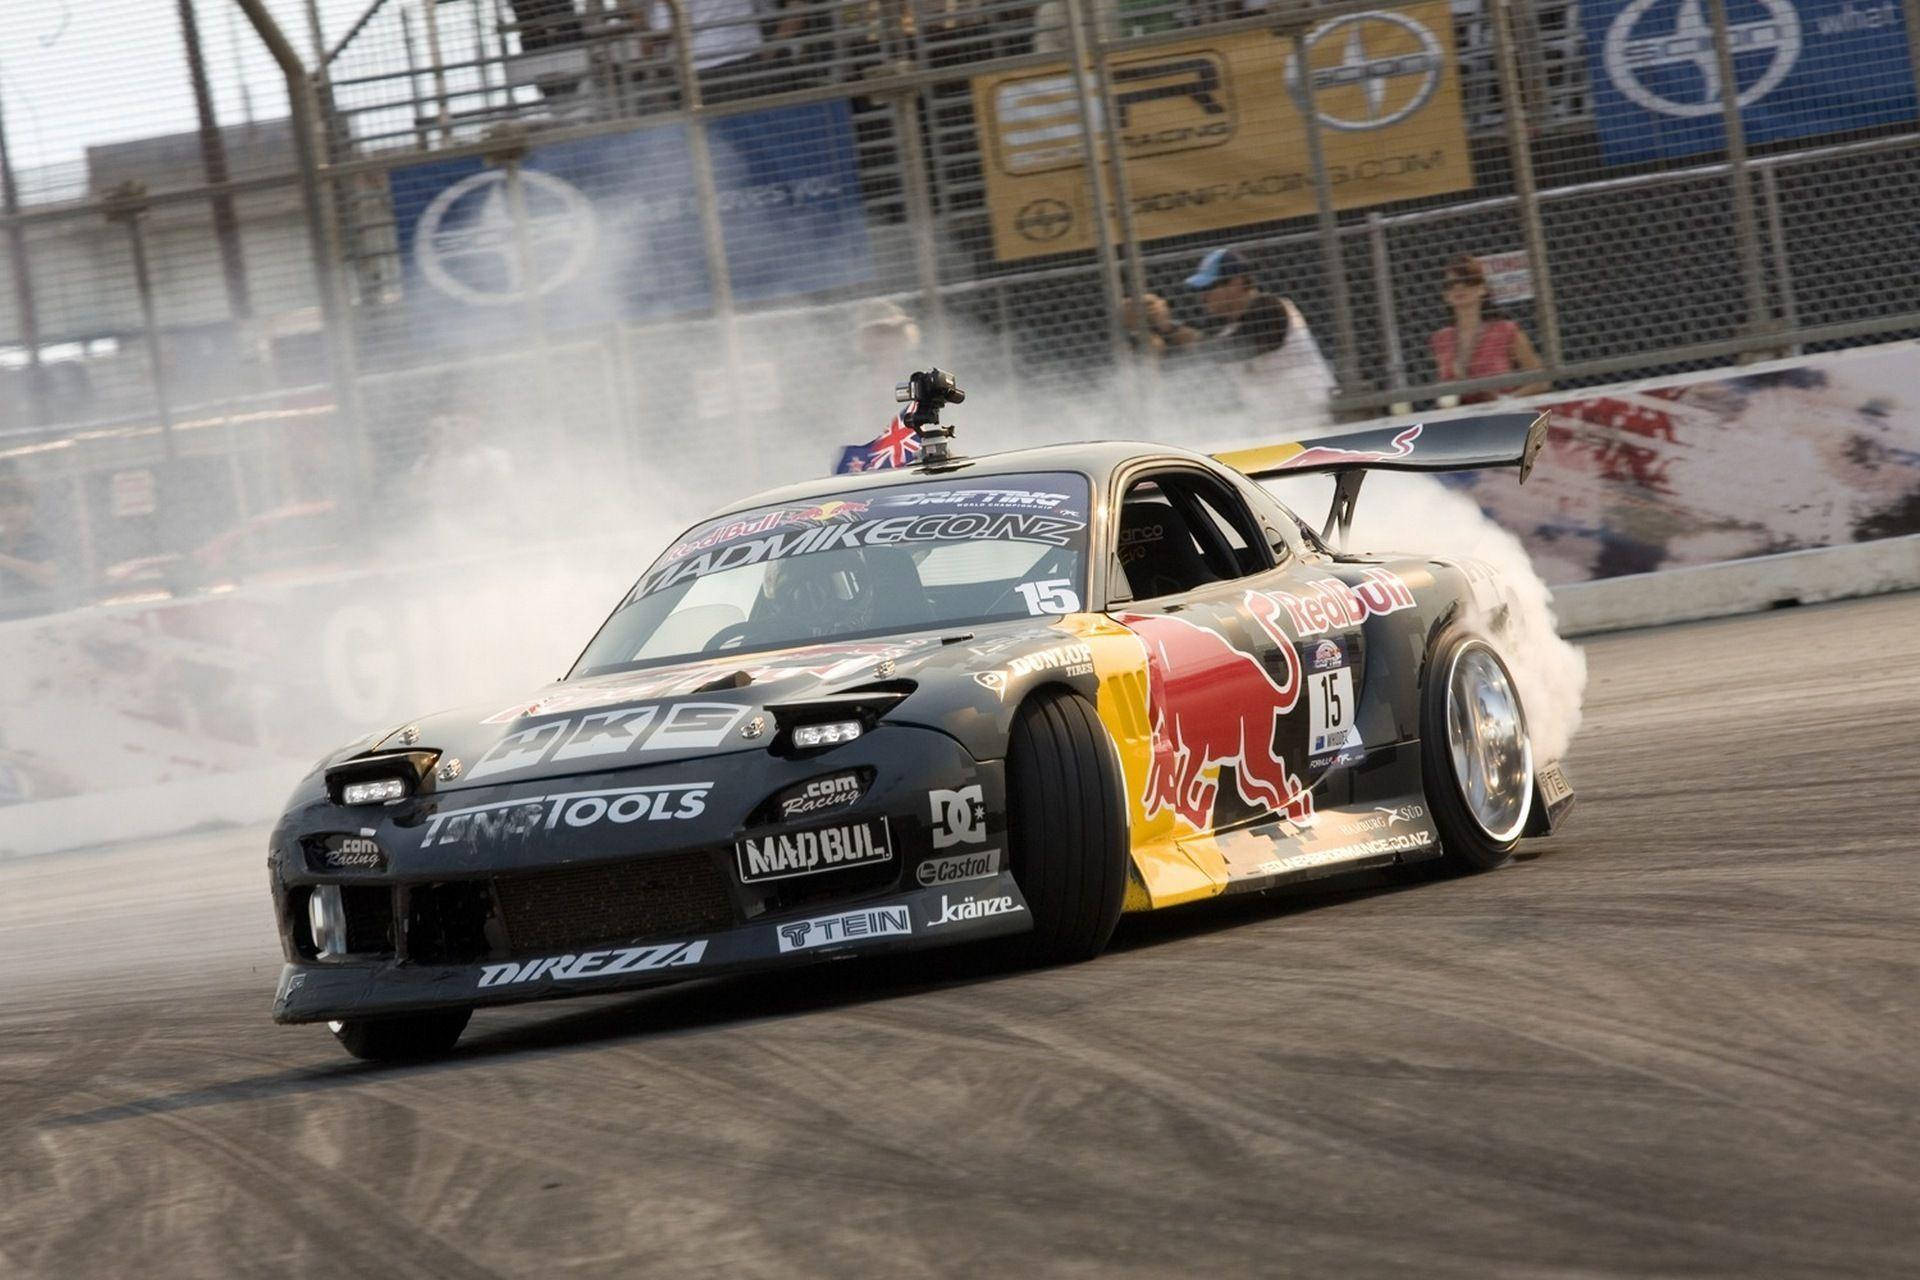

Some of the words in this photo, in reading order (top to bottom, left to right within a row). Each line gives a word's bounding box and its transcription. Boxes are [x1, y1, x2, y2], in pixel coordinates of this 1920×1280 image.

[1014, 578, 1080, 616] 15
[1007, 643, 1092, 677] DUNLOP
[1065, 662, 1094, 677] TIRES
[1321, 672, 1341, 729] 15
[465, 702, 752, 781] HKS
[782, 789, 861, 817] Racing
[802, 775, 858, 799] .com
[928, 784, 987, 849] DC
[1340, 816, 1387, 836] HAMBURG
[1401, 805, 1423, 821] SÜD
[326, 847, 380, 868] Racing
[937, 854, 992, 881] Castrol
[814, 907, 908, 941] TEIN
[477, 940, 708, 988] DIREZZA
